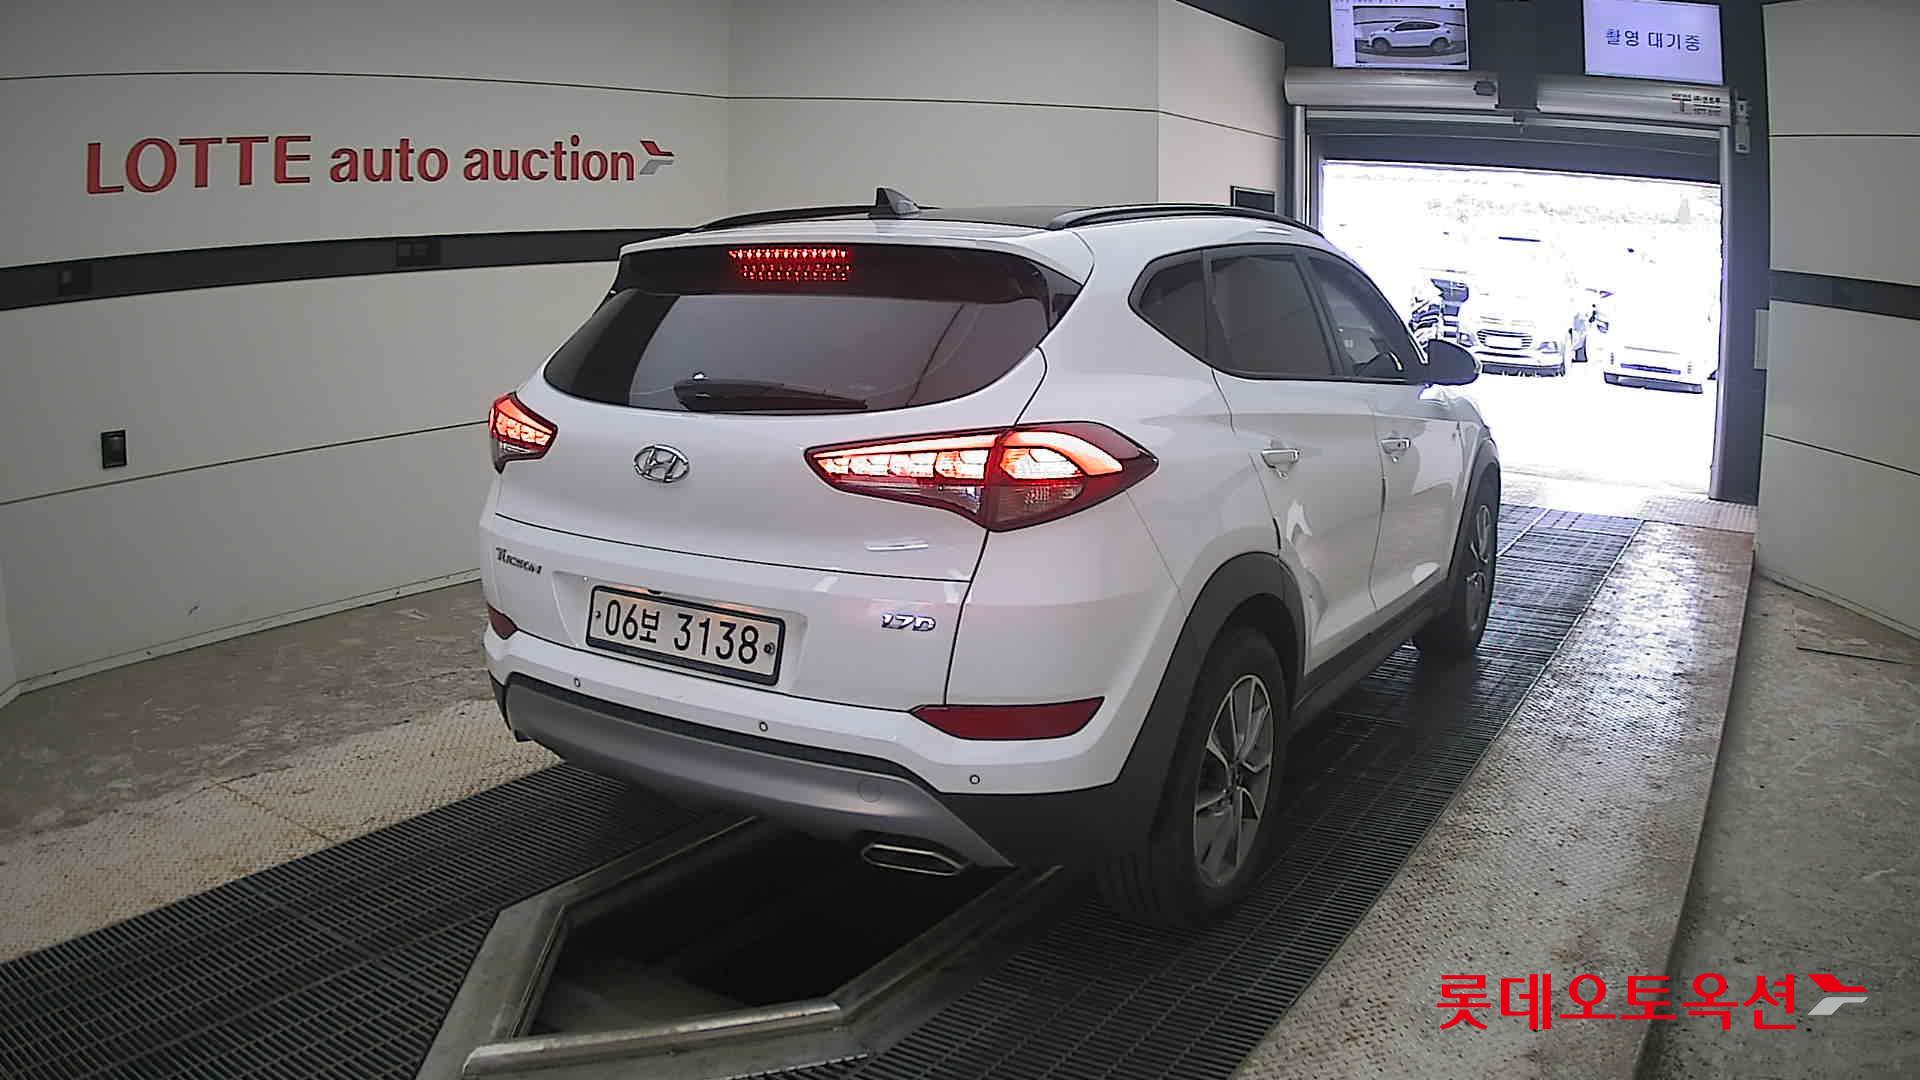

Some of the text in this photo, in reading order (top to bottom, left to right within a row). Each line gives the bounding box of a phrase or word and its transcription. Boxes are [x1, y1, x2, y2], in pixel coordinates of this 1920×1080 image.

[1648, 32, 1700, 51] 대기중
[86, 134, 635, 194] LOTTE auto auction
[605, 600, 759, 665] 06보 3138
